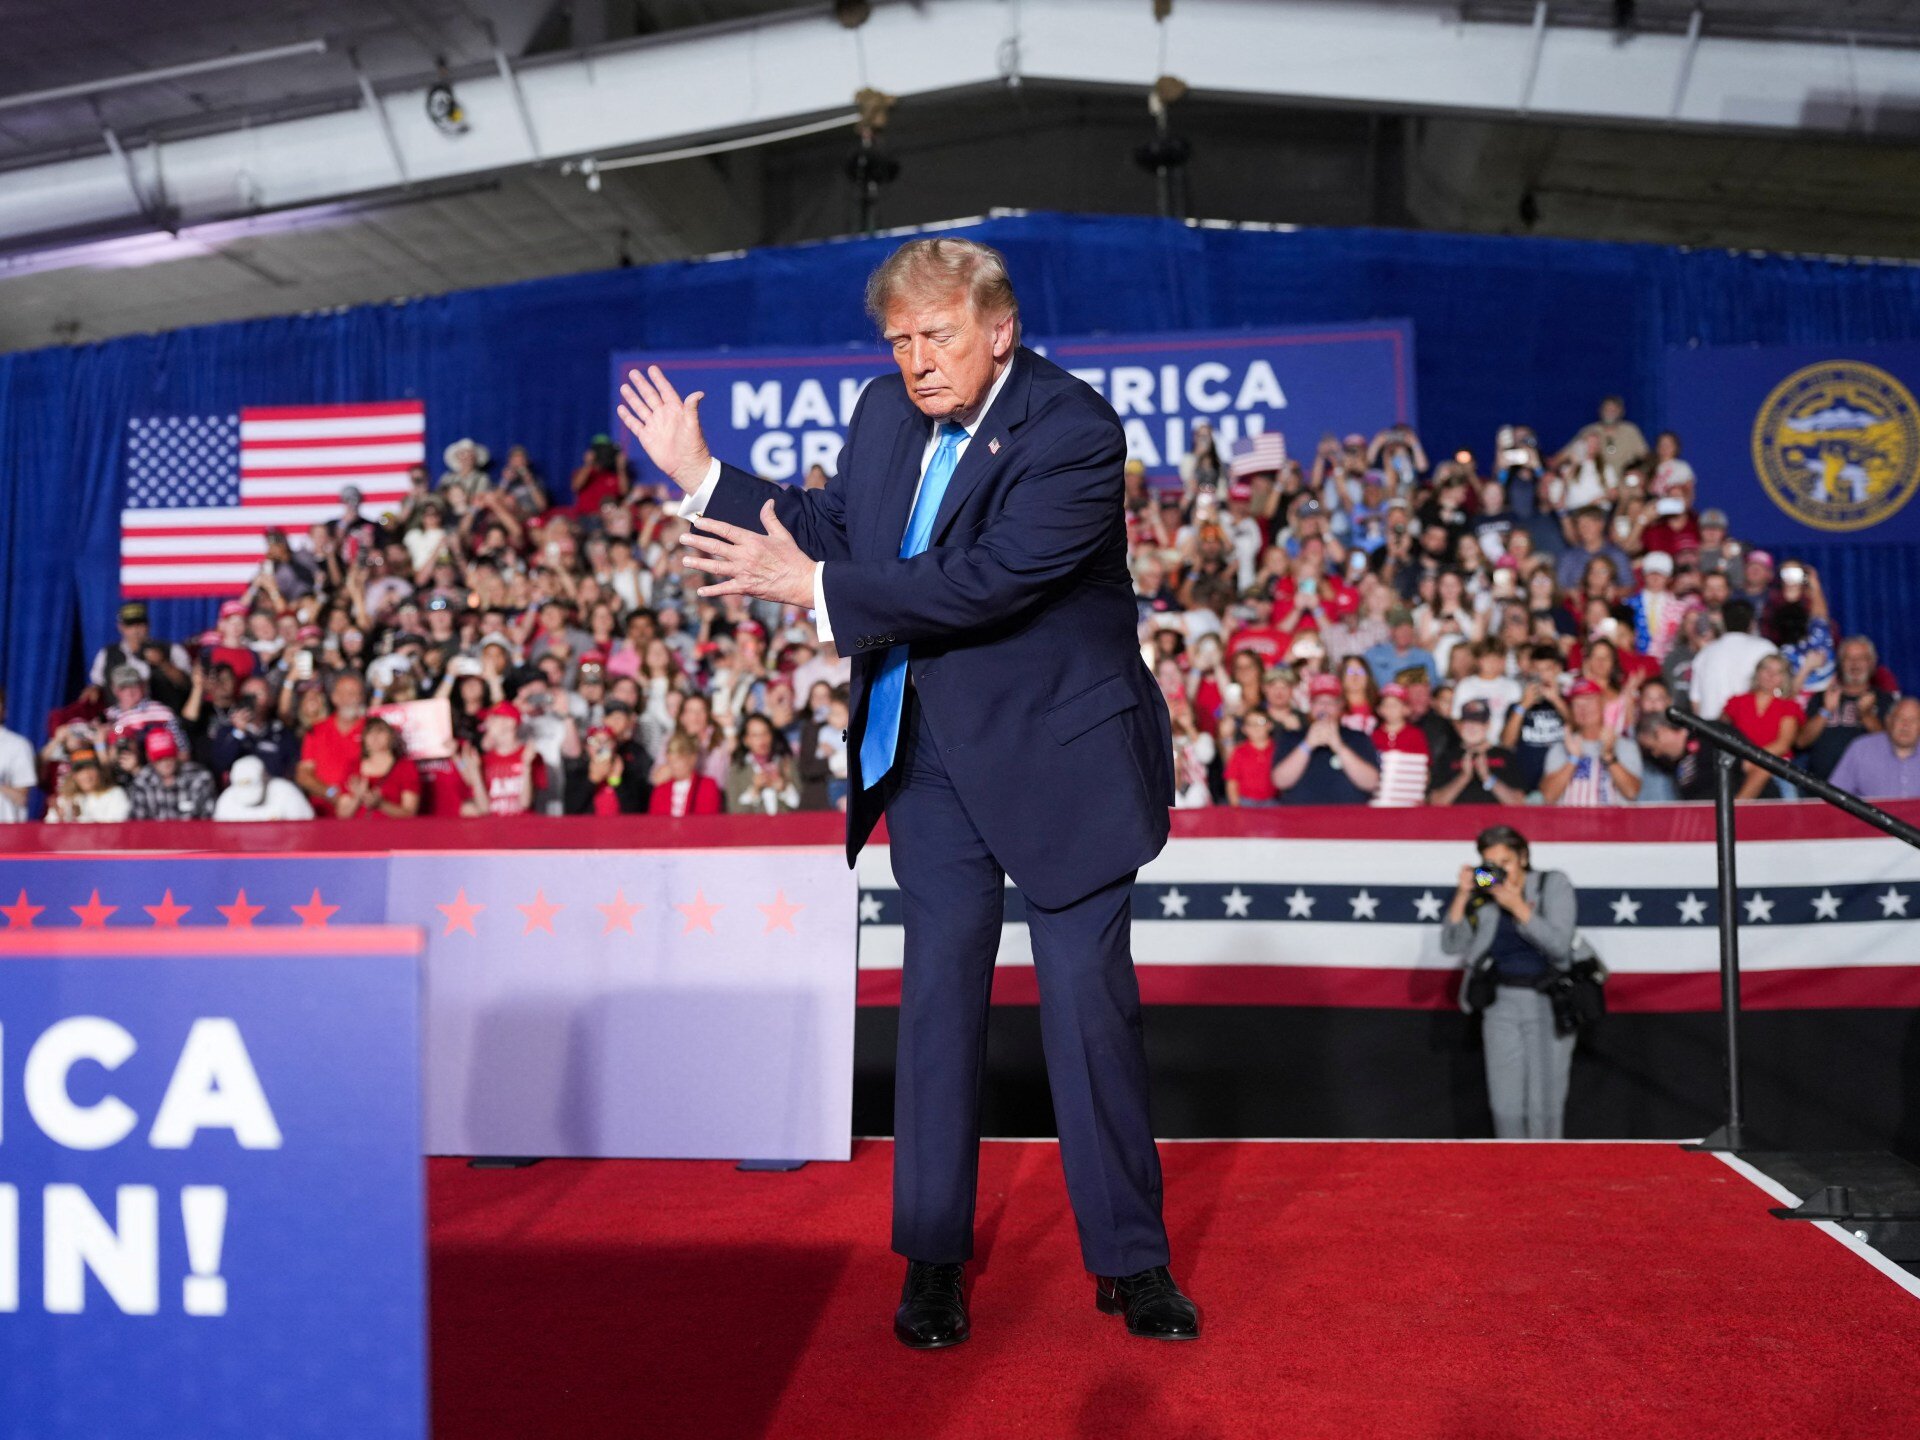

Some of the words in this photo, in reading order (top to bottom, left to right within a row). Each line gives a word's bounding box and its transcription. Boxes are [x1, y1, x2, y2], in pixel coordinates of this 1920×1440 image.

[731, 377, 877, 429] MAK
[1066, 360, 1287, 415] RICA
[0, 1014, 284, 1151] CA
